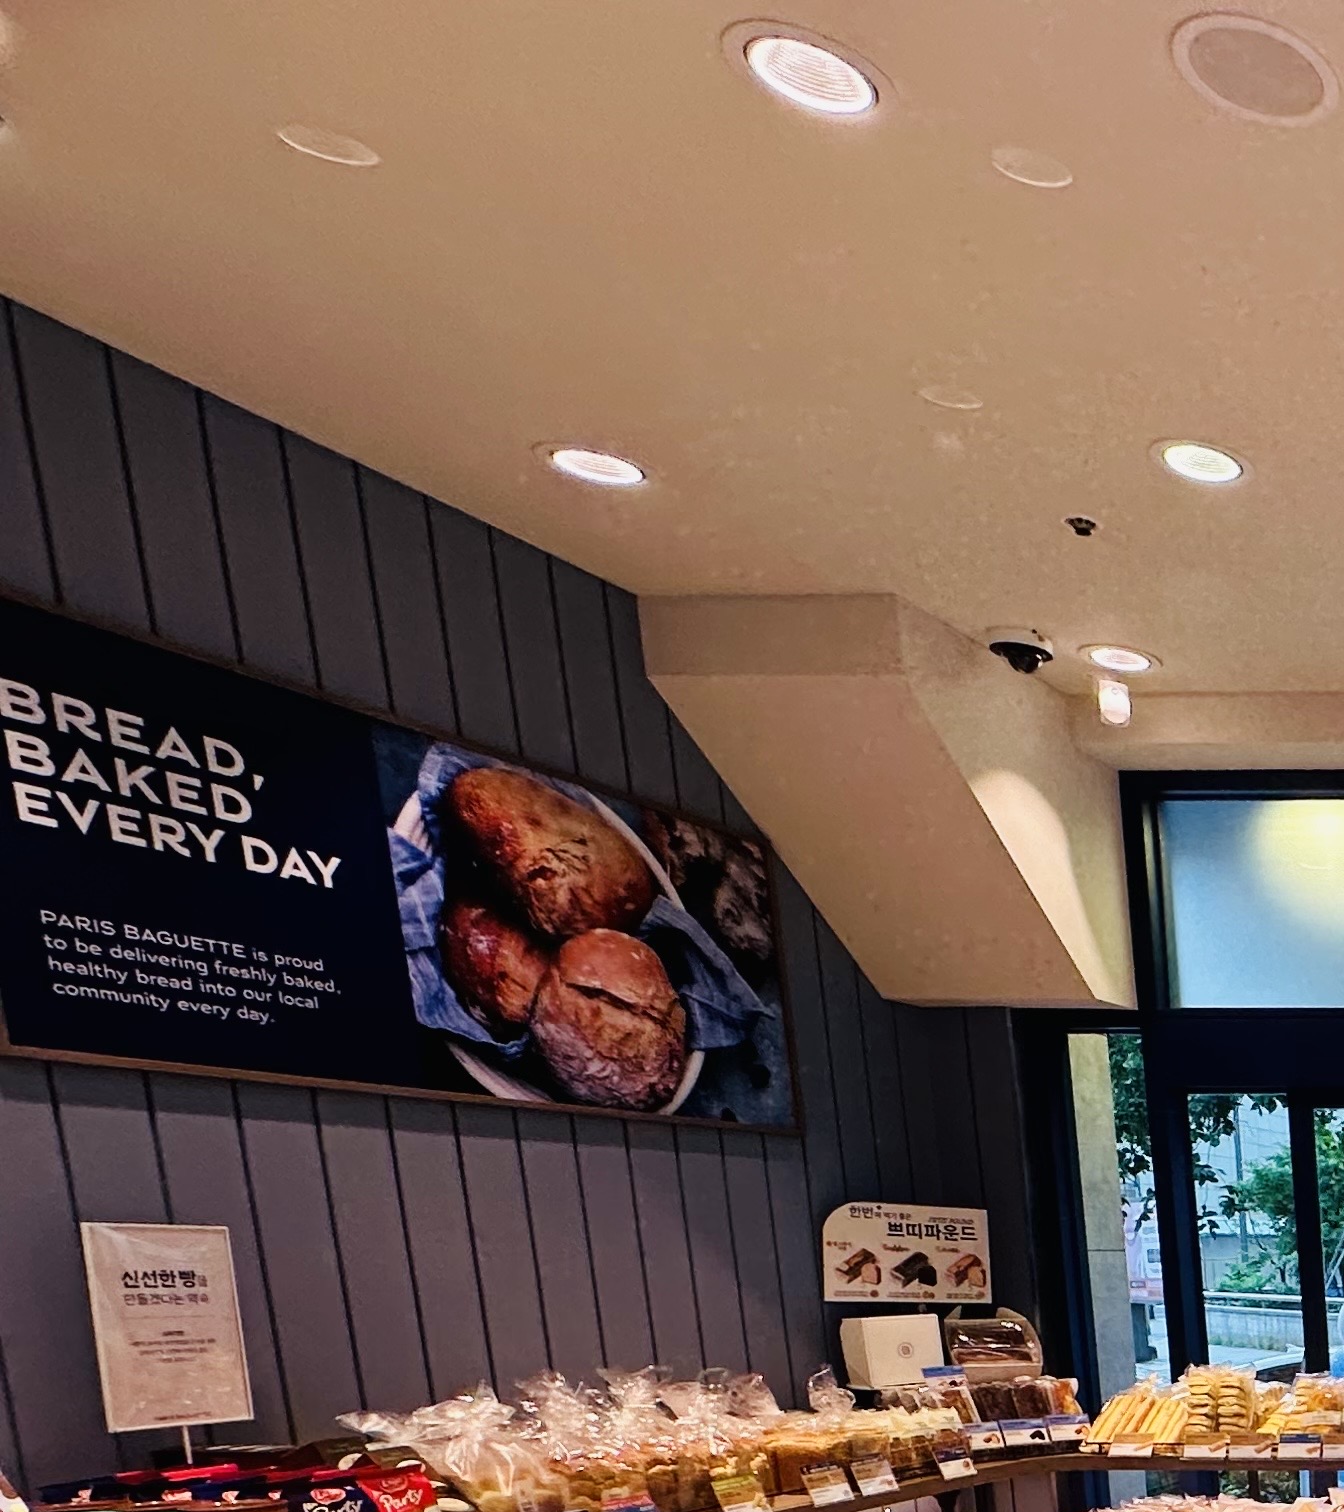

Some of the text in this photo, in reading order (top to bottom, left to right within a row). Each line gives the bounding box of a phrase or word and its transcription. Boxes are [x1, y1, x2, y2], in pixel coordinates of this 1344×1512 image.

[0, 677, 265, 791] BREAD,
[3, 729, 252, 824] BAKED
[12, 781, 342, 889] EVERY DAY
[40, 909, 324, 972] PARIS BAGUETTE is proud
[43, 934, 67, 950] to
[75, 937, 102, 956] be
[109, 944, 208, 976] delivering
[214, 960, 277, 987] freshly
[48, 955, 319, 1009] healthy bread into our local
[52, 981, 275, 1025] community every day.
[887, 1221, 978, 1242] 쁘띠파운드
[121, 1269, 177, 1289] 신선한
